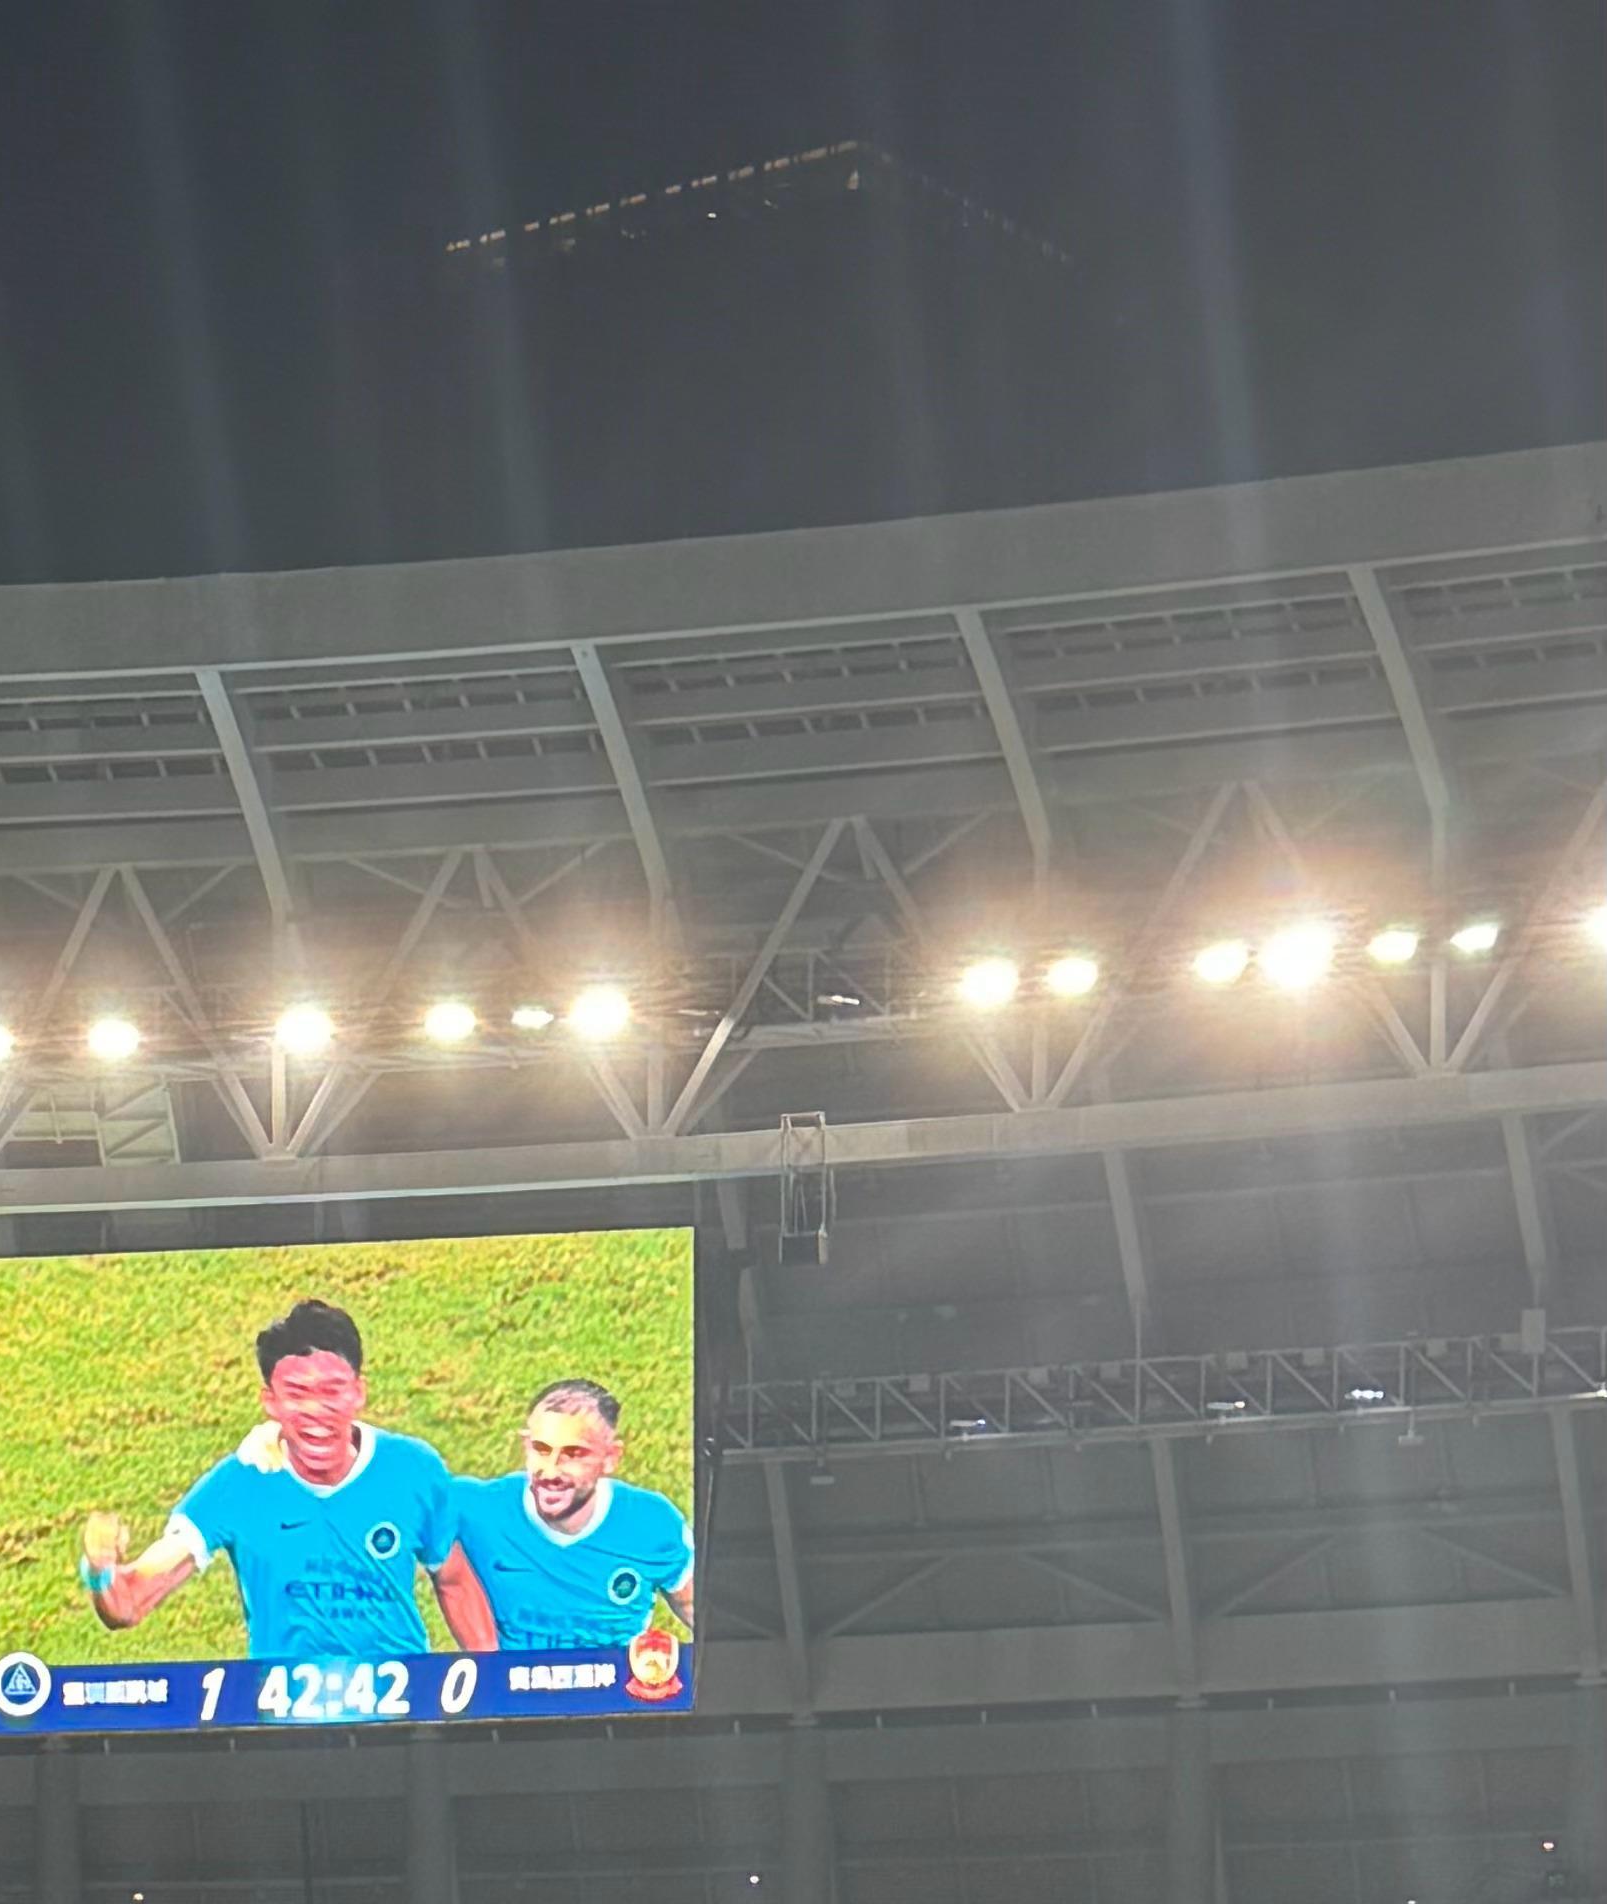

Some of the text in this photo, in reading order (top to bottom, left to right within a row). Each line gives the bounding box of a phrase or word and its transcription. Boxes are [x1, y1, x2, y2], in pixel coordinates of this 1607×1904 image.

[199, 1668, 225, 1720] 1
[258, 1660, 410, 1718] 42:42
[440, 1658, 477, 1713] 0
